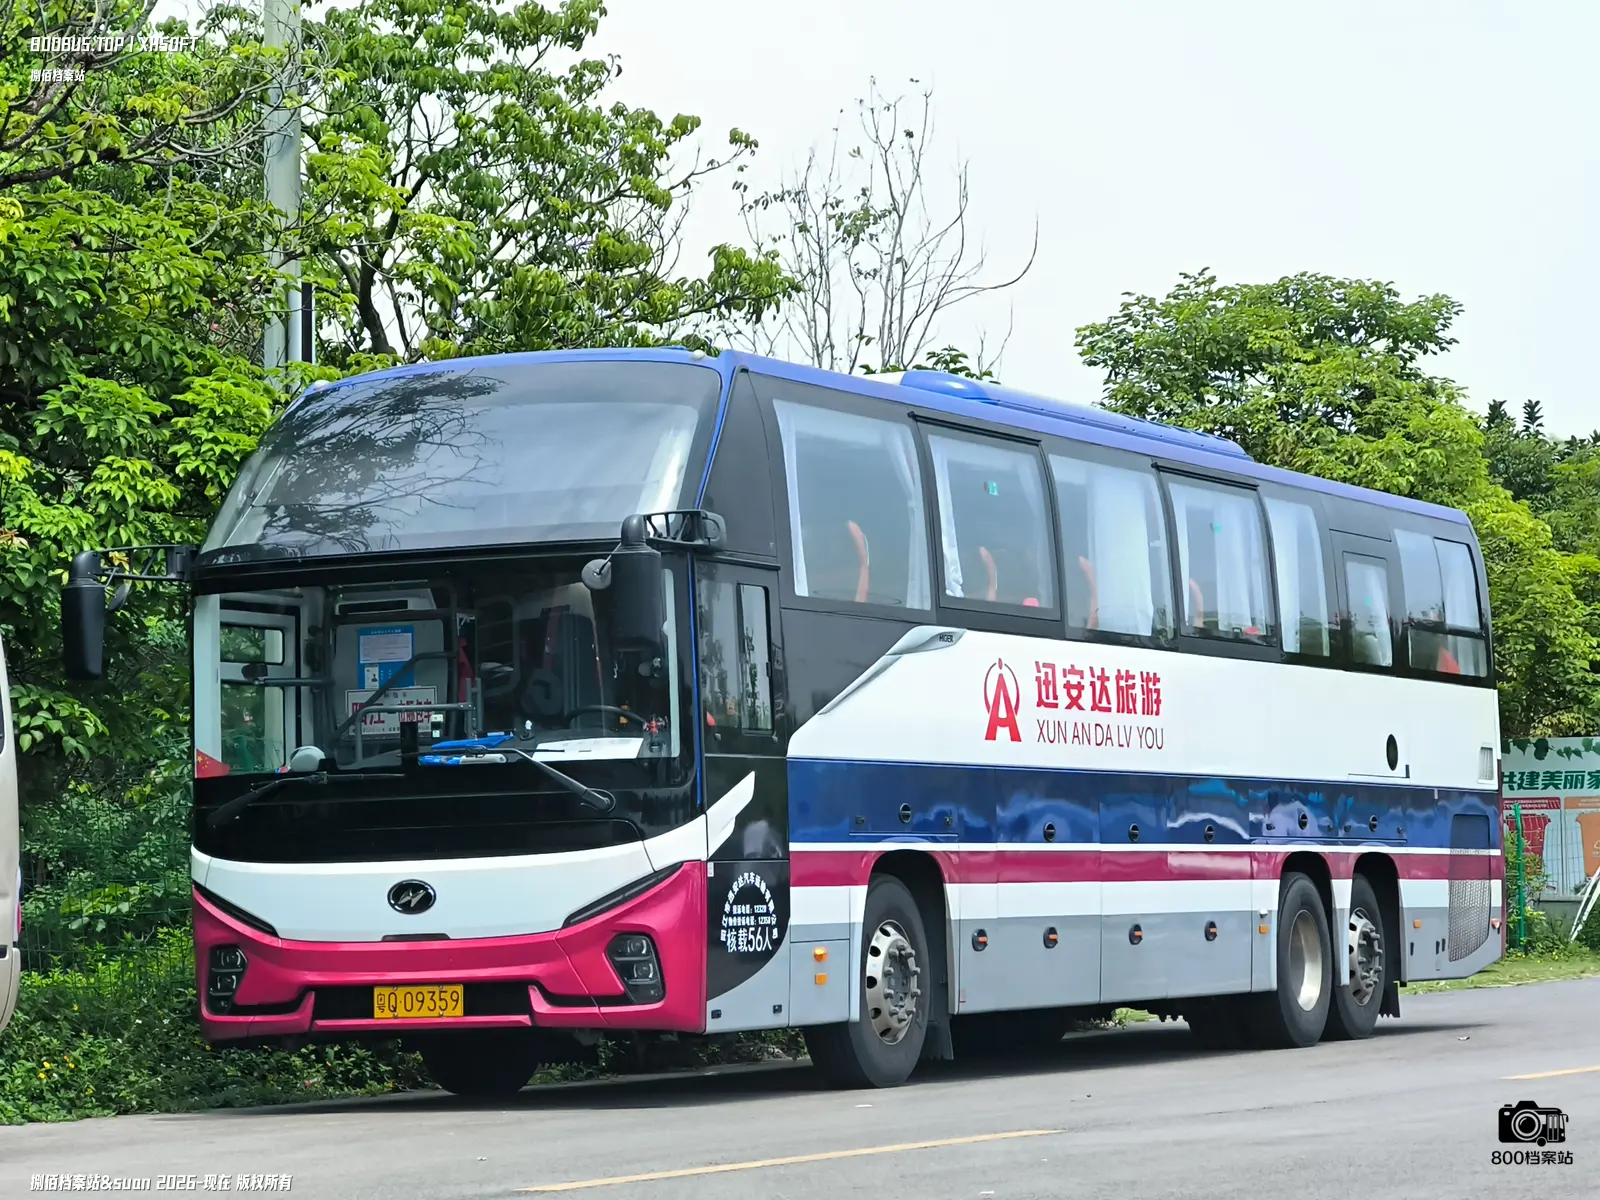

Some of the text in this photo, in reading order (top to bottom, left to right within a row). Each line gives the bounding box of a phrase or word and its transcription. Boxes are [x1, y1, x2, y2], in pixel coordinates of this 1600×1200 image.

[1034, 660, 1162, 716] 迅安达旅游
[1037, 719, 1067, 744] XUN
[1118, 724, 1132, 748] LV
[1137, 725, 1164, 750] YOU
[726, 926, 772, 953] 核载56人
